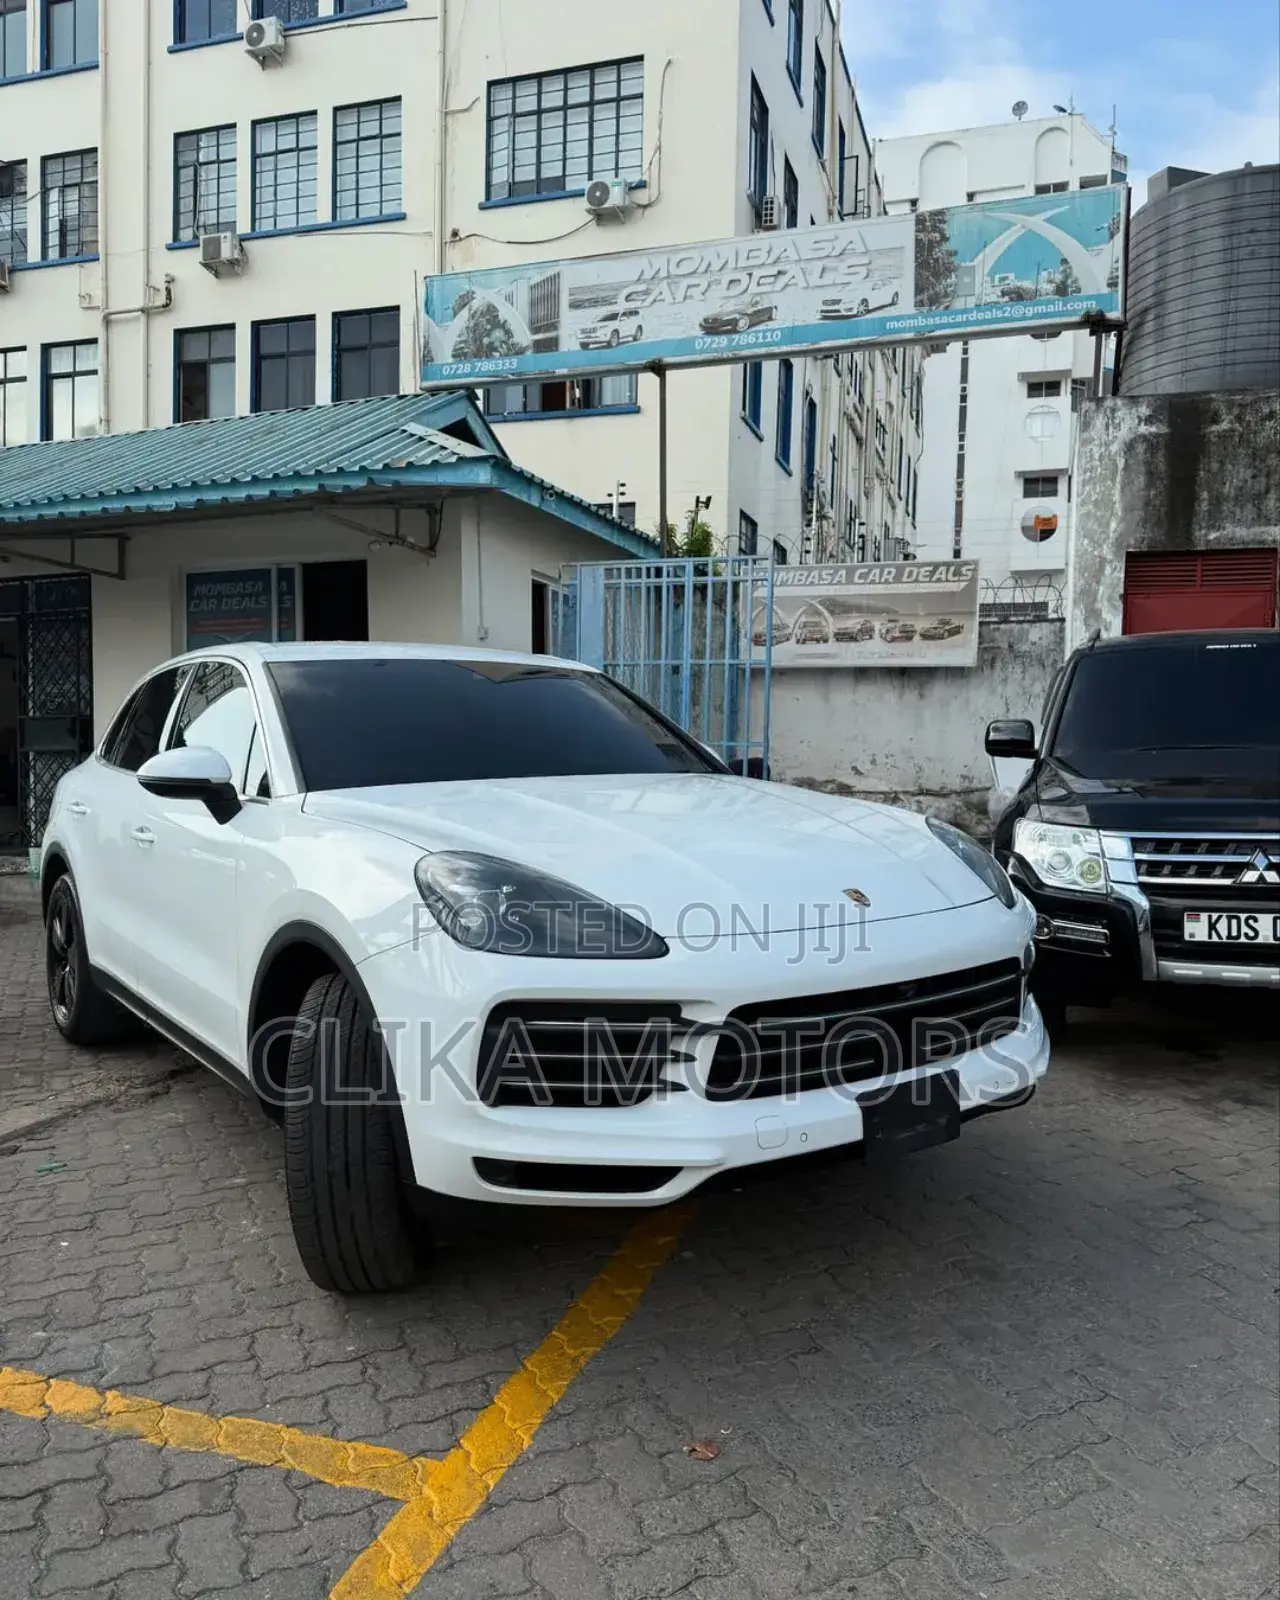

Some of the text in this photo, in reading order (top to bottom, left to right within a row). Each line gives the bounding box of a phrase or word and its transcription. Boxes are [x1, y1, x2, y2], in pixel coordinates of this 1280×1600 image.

[637, 230, 868, 281] MOMBASA
[617, 257, 872, 307] CAR DEALS
[886, 300, 1096, 329] mombasacardeals2@gmail.com
[695, 330, 782, 351] 0729 786110
[442, 359, 518, 375] 0728 786333
[753, 565, 975, 587] MBASA CAR DEALS
[194, 581, 263, 596] MOMBASA
[189, 599, 217, 611] CAR
[222, 596, 268, 610] DEALS
[1207, 914, 1260, 942] KDS
